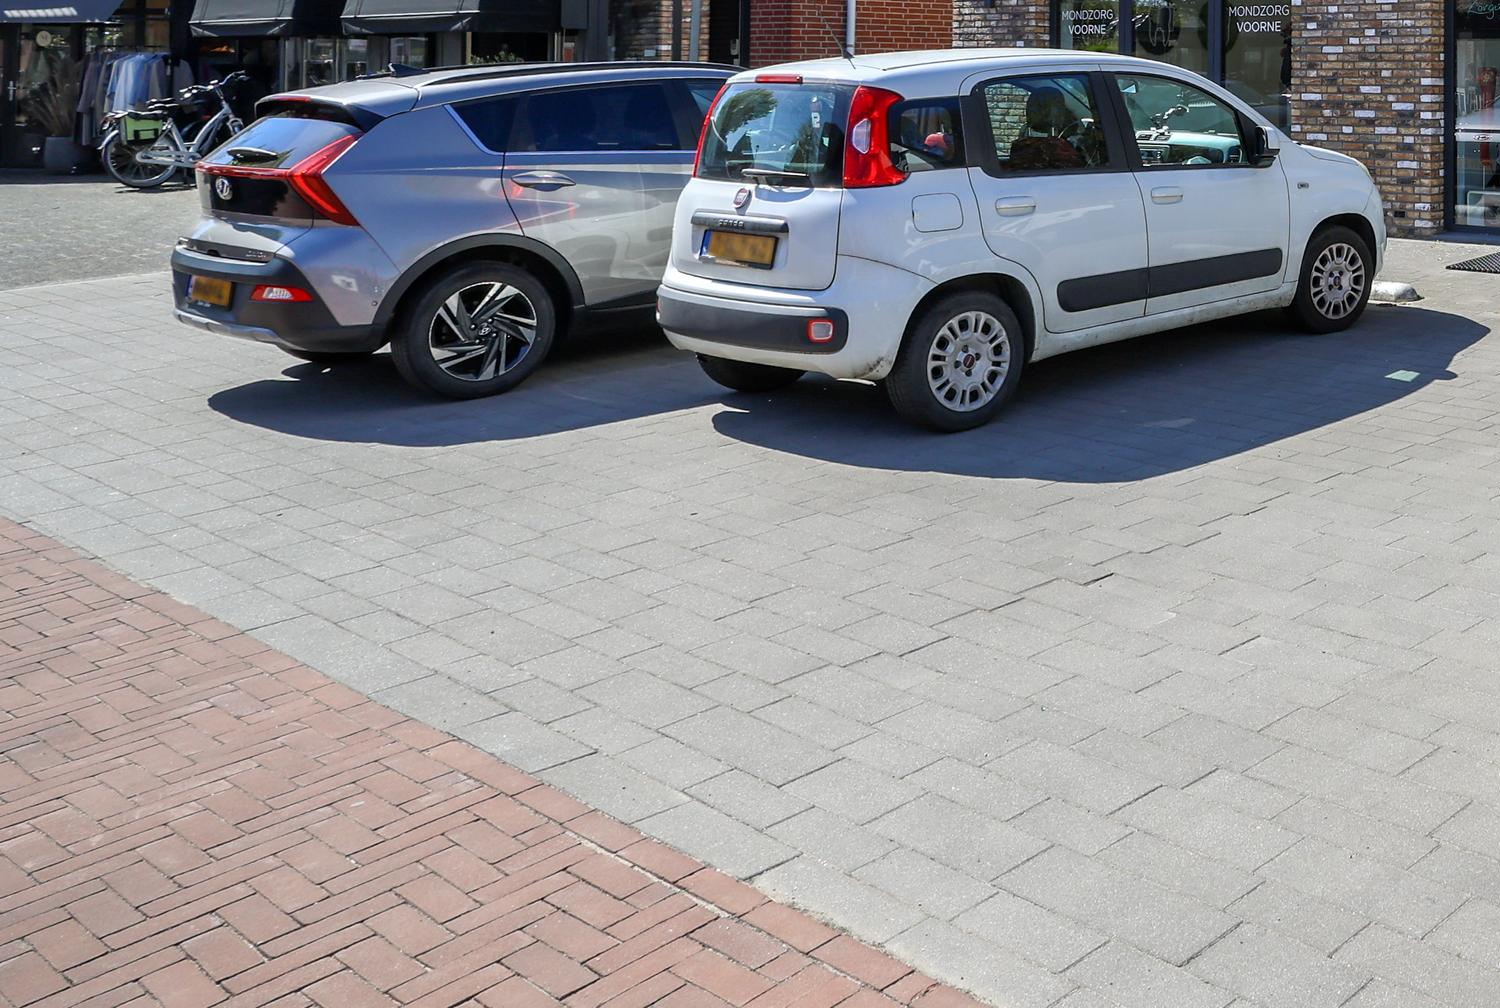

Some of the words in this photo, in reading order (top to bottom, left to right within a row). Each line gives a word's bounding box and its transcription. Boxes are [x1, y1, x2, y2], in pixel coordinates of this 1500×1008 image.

[1062, 9, 1114, 21] MONDZORG
[1228, 4, 1290, 17] MONDZORG
[1068, 24, 1107, 35] VOORNE
[1236, 20, 1282, 32] VOORNE
